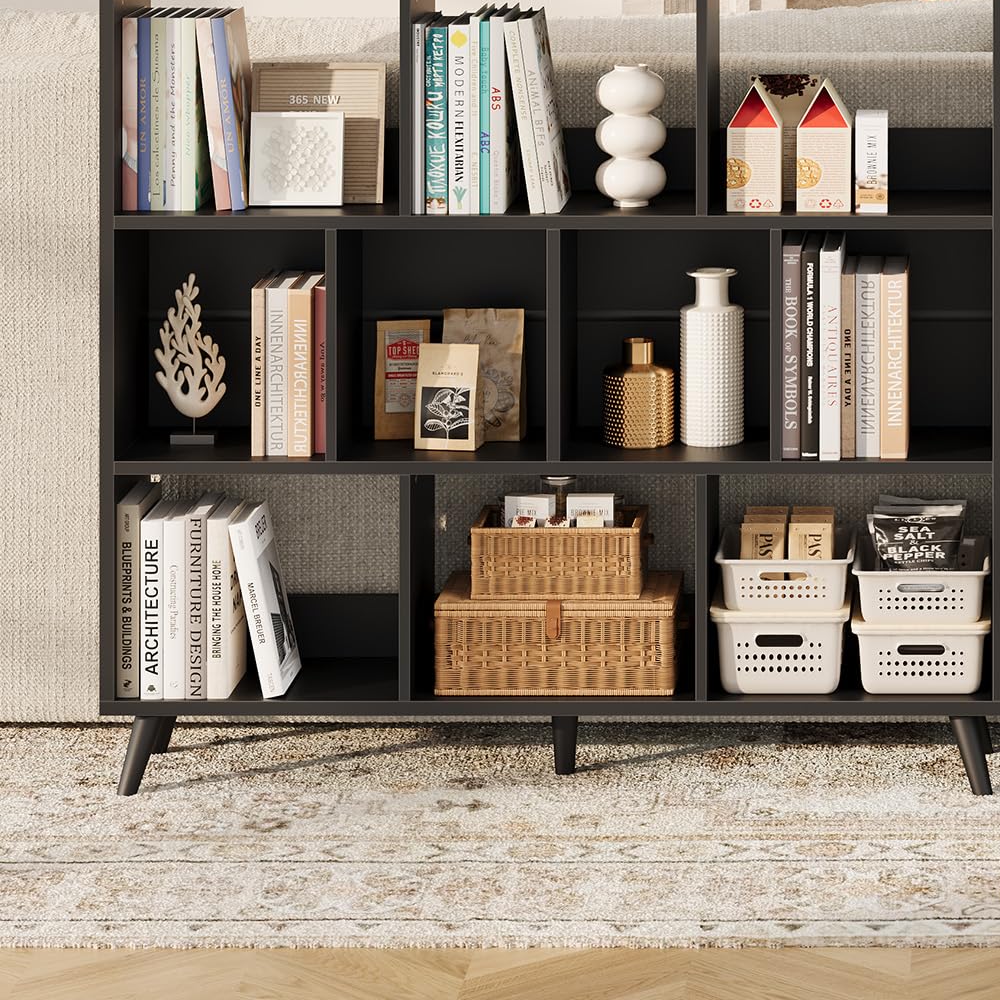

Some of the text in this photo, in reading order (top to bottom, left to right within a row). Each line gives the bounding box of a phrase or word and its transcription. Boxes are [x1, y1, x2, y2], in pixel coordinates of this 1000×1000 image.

[153, 87, 160, 103] de
[289, 95, 341, 104] 365 NEW
[491, 86, 501, 111] ABS
[220, 77, 234, 153] UN AMOR
[454, 56, 464, 182] MODERN FLEXITARIAN
[140, 130, 147, 153] UN
[426, 91, 446, 194] ПЛОХИЕ КОШКИ
[481, 131, 490, 154] ABC
[866, 135, 877, 148] MIX
[866, 152, 877, 185] BROWNIE
[806, 262, 814, 296] FORMULA
[785, 296, 797, 338] BOOK
[806, 301, 814, 326] WORLD
[388, 346, 402, 356] TOP
[785, 342, 792, 352] OF
[806, 327, 814, 367] CHAMPIONS
[825, 305, 838, 407] ANTIQUAIRES
[888, 279, 902, 426] INNENARCHITEKTUR
[270, 310, 283, 450] INNENARCHITEKTUR
[785, 354, 797, 430] SYMBOLS
[759, 533, 774, 559] PAS
[808, 533, 822, 559] PAS
[887, 544, 942, 554] BLACK
[894, 532, 935, 541] SALT
[122, 541, 132, 604] BLUEPRINTS
[883, 552, 946, 561] PEPPER
[122, 606, 132, 614] &
[145, 539, 158, 675] ARCHITECTURE
[190, 518, 202, 697] FURNITURE DESIGN
[212, 560, 221, 659] BRINGING THE HOUSE HOME
[247, 582, 266, 644] MARCEL BREUER
[122, 616, 132, 670] BUILDINGS
